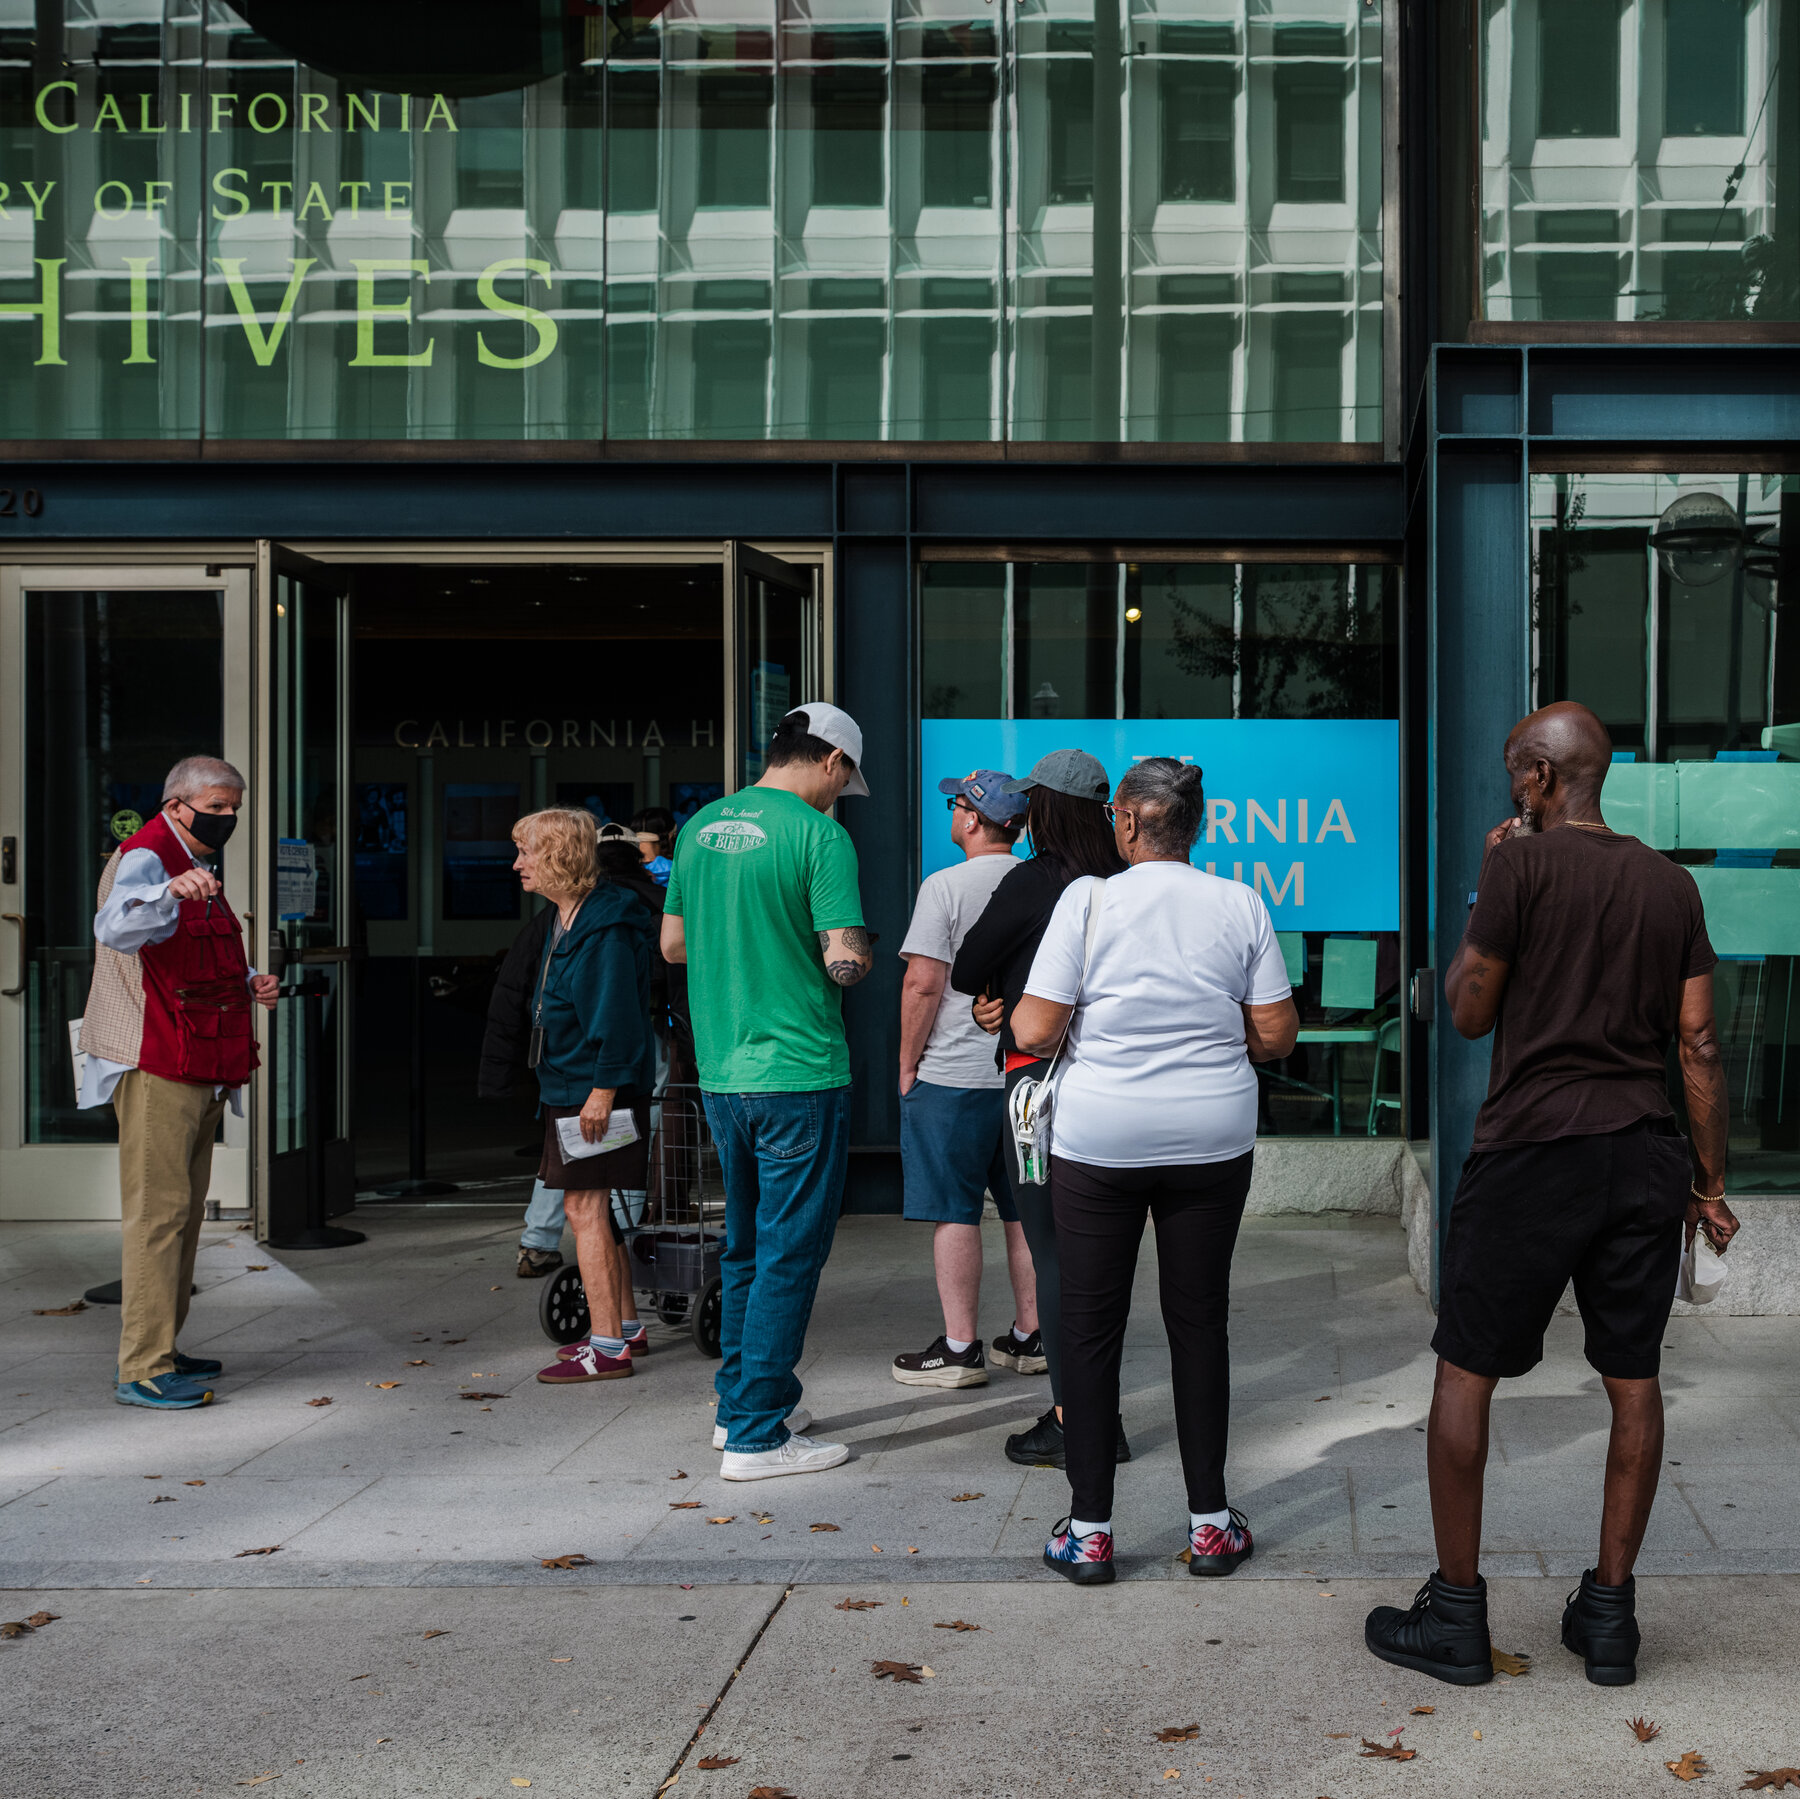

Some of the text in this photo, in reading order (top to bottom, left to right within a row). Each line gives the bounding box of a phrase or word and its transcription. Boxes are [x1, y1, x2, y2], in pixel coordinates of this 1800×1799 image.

[34, 80, 460, 134] CALIFORNIA
[211, 167, 415, 222] STATE
[394, 718, 666, 748] CALIFORNIA
[733, 808, 764, 819] Annual
[715, 834, 741, 850] BIKE
[921, 1357, 945, 1368] HOKA
